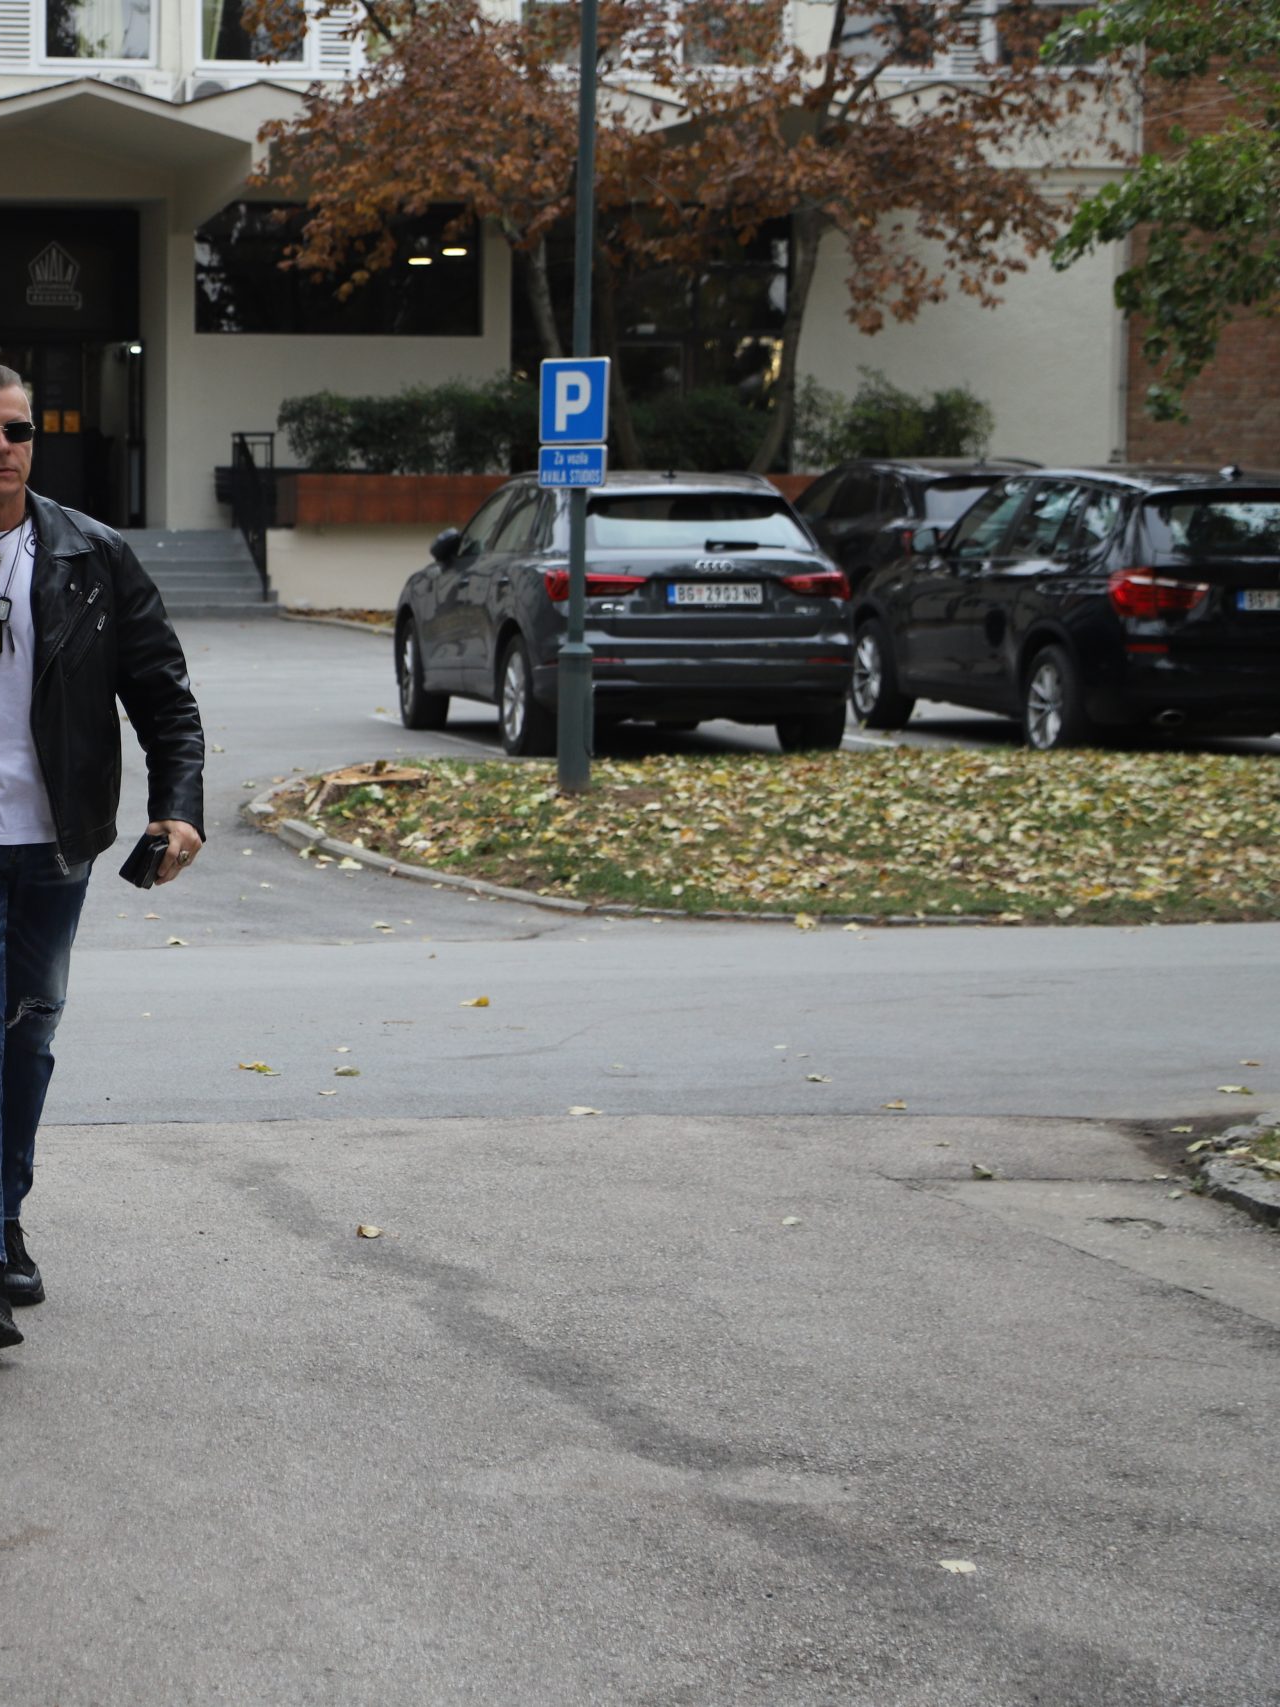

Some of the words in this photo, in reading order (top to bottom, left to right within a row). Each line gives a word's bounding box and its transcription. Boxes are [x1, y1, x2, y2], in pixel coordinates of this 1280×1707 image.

[555, 371, 592, 432] P
[554, 451, 564, 465] Za
[542, 469, 566, 483] AVALA
[678, 586, 695, 601] BG
